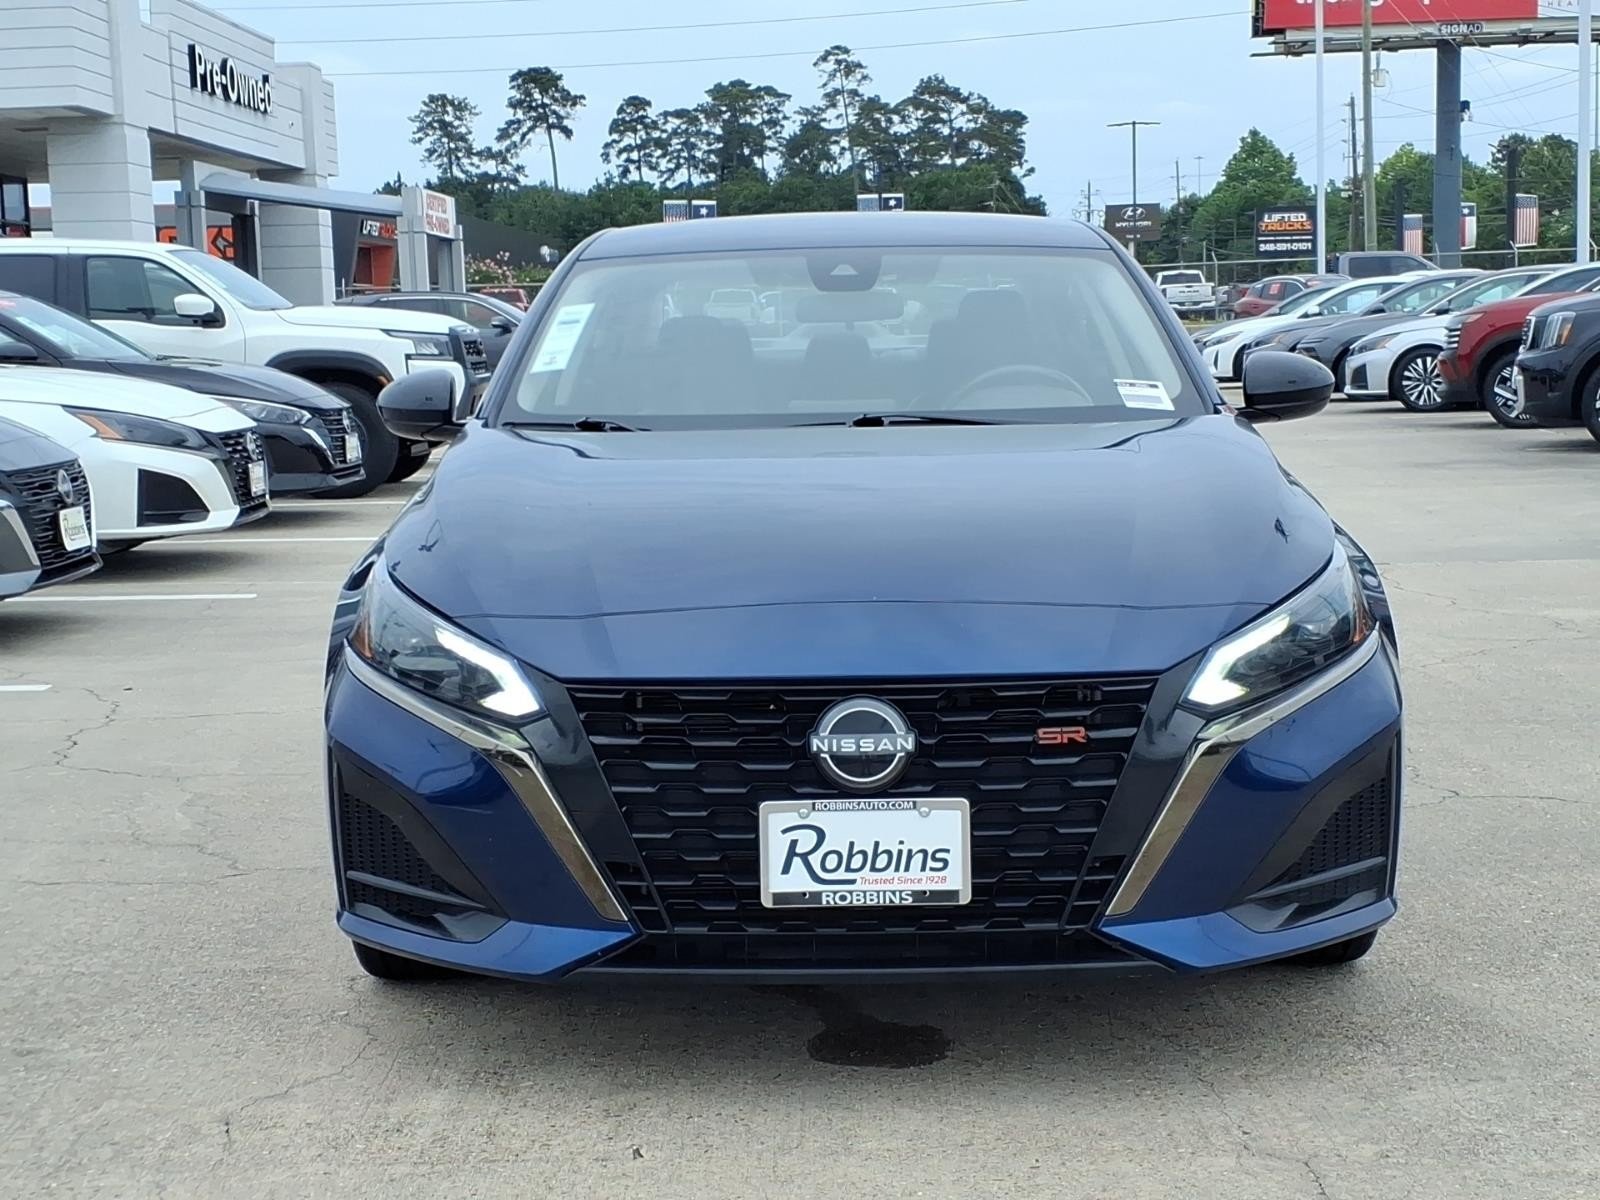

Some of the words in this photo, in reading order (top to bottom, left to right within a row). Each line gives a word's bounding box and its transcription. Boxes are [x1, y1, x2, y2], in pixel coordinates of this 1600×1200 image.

[188, 44, 273, 114] Pre-Owned
[1264, 213, 1306, 222] LIFTED
[1259, 220, 1313, 233] TRUCKS
[1036, 726, 1087, 744] SR
[812, 737, 913, 752] NISSAN
[815, 801, 914, 811] ROBBINSAUTO.COM
[780, 823, 951, 885] Robbins
[859, 875, 895, 885] Trusted
[897, 875, 922, 885] Since
[925, 875, 947, 884] 1928
[821, 890, 913, 905] ROBBINS
